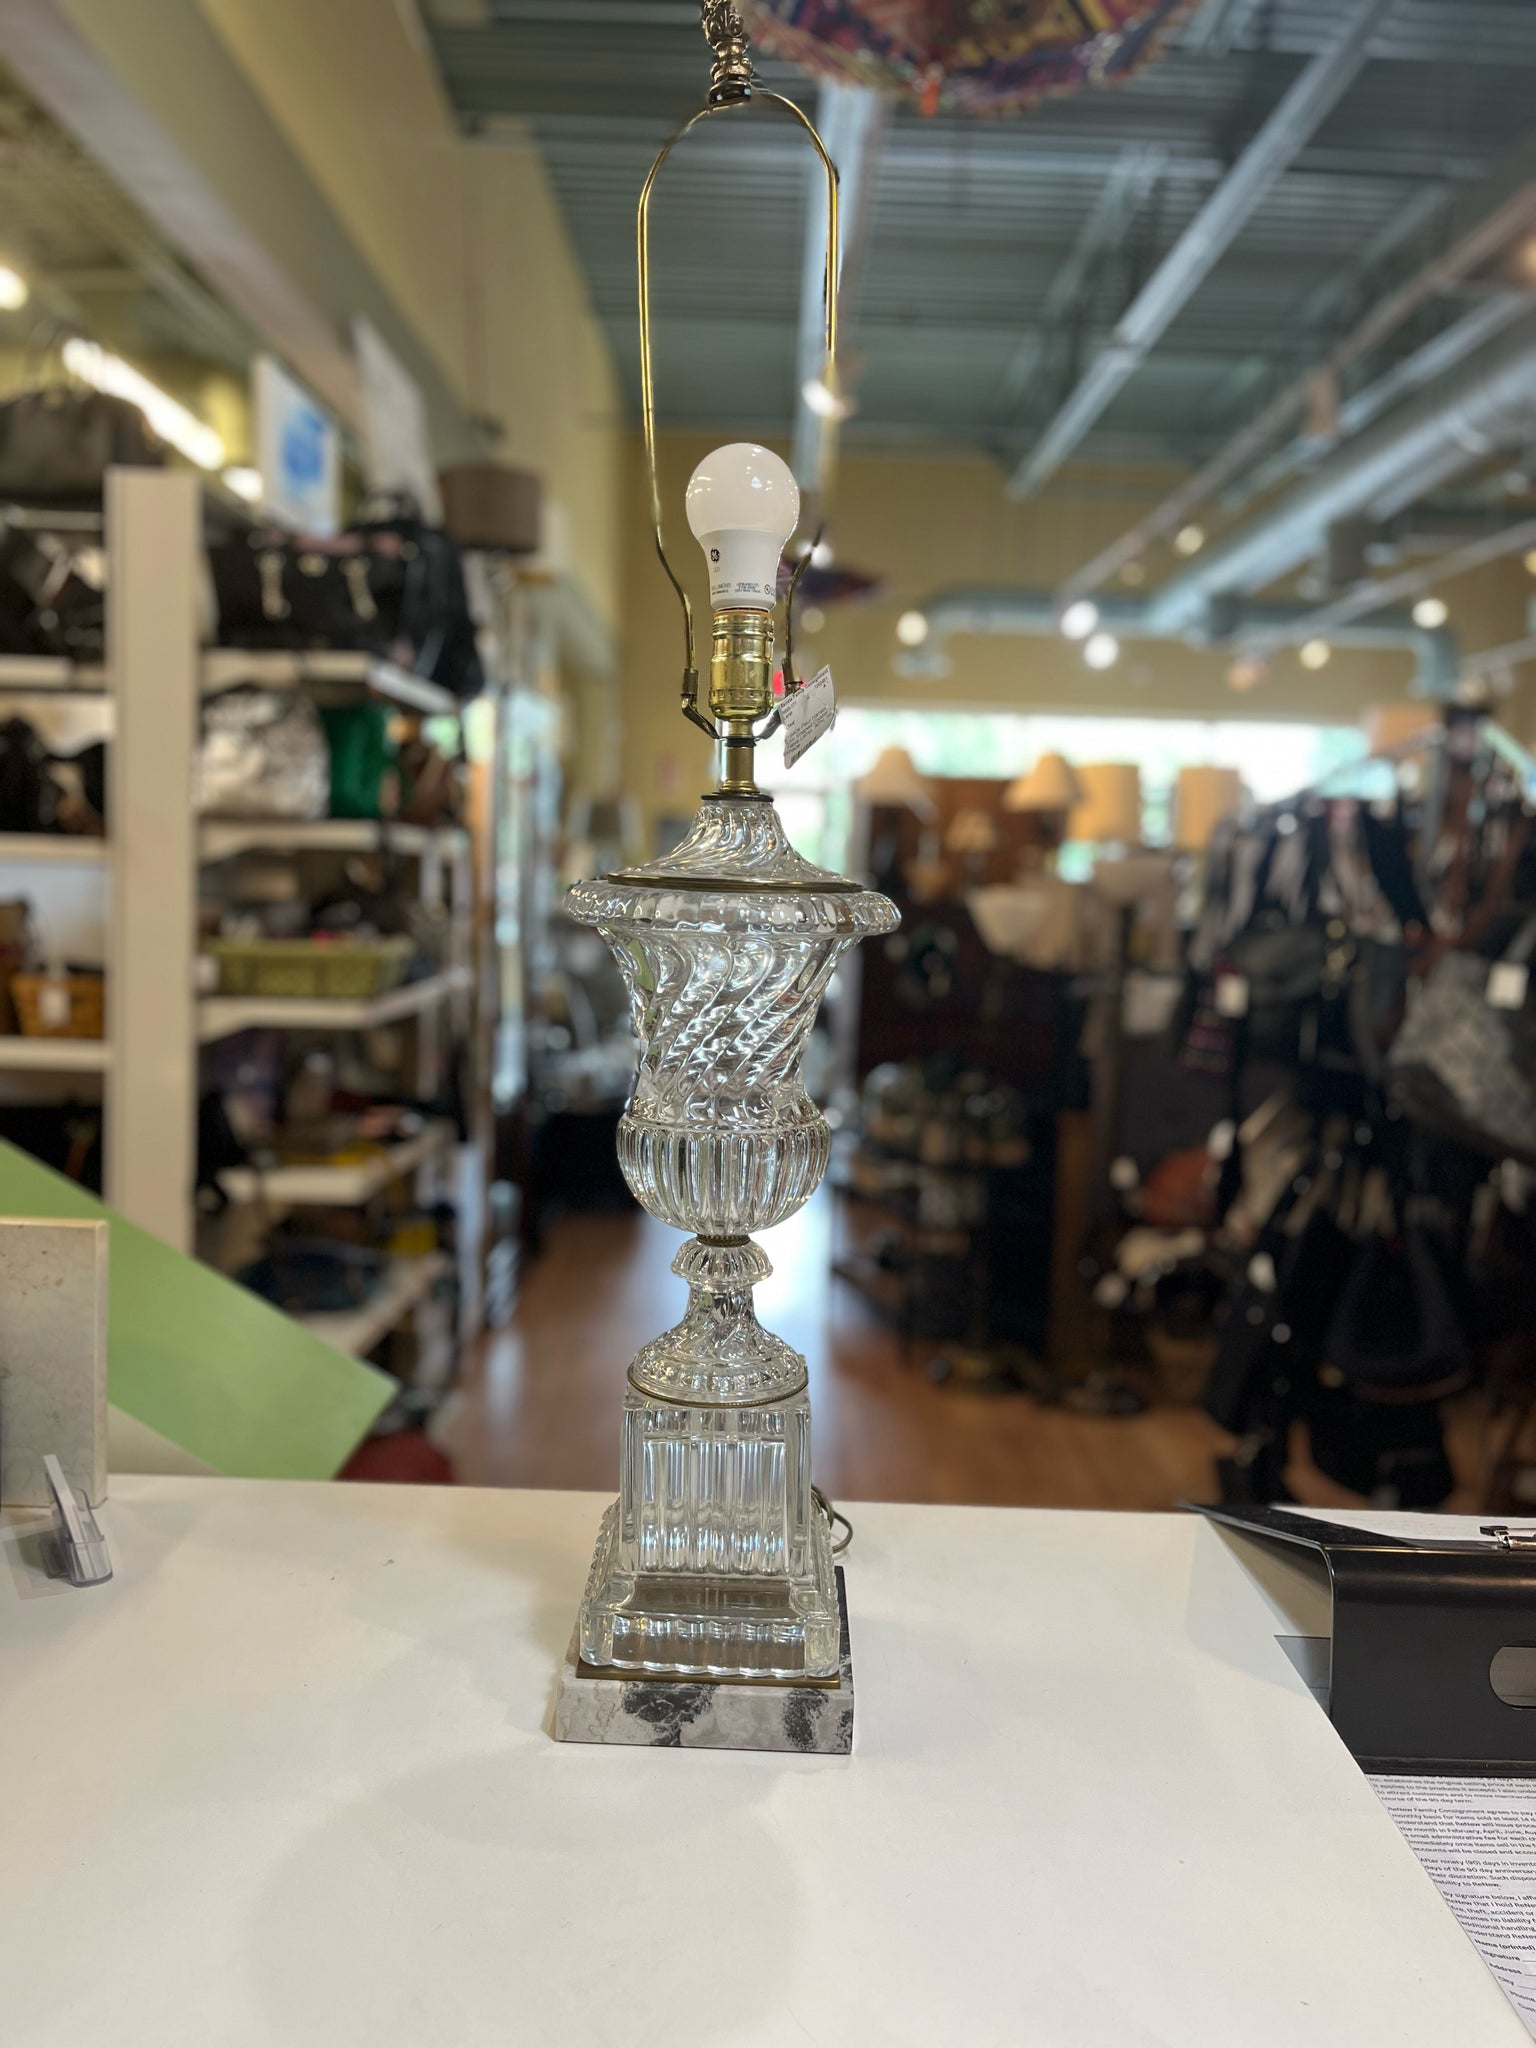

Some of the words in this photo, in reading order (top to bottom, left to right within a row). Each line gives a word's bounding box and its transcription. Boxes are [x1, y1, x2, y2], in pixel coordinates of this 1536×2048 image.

[1474, 1939, 1498, 1948] Name
[1499, 1943, 1536, 1951] (printed)
[1481, 1950, 1520, 1961] Signature
